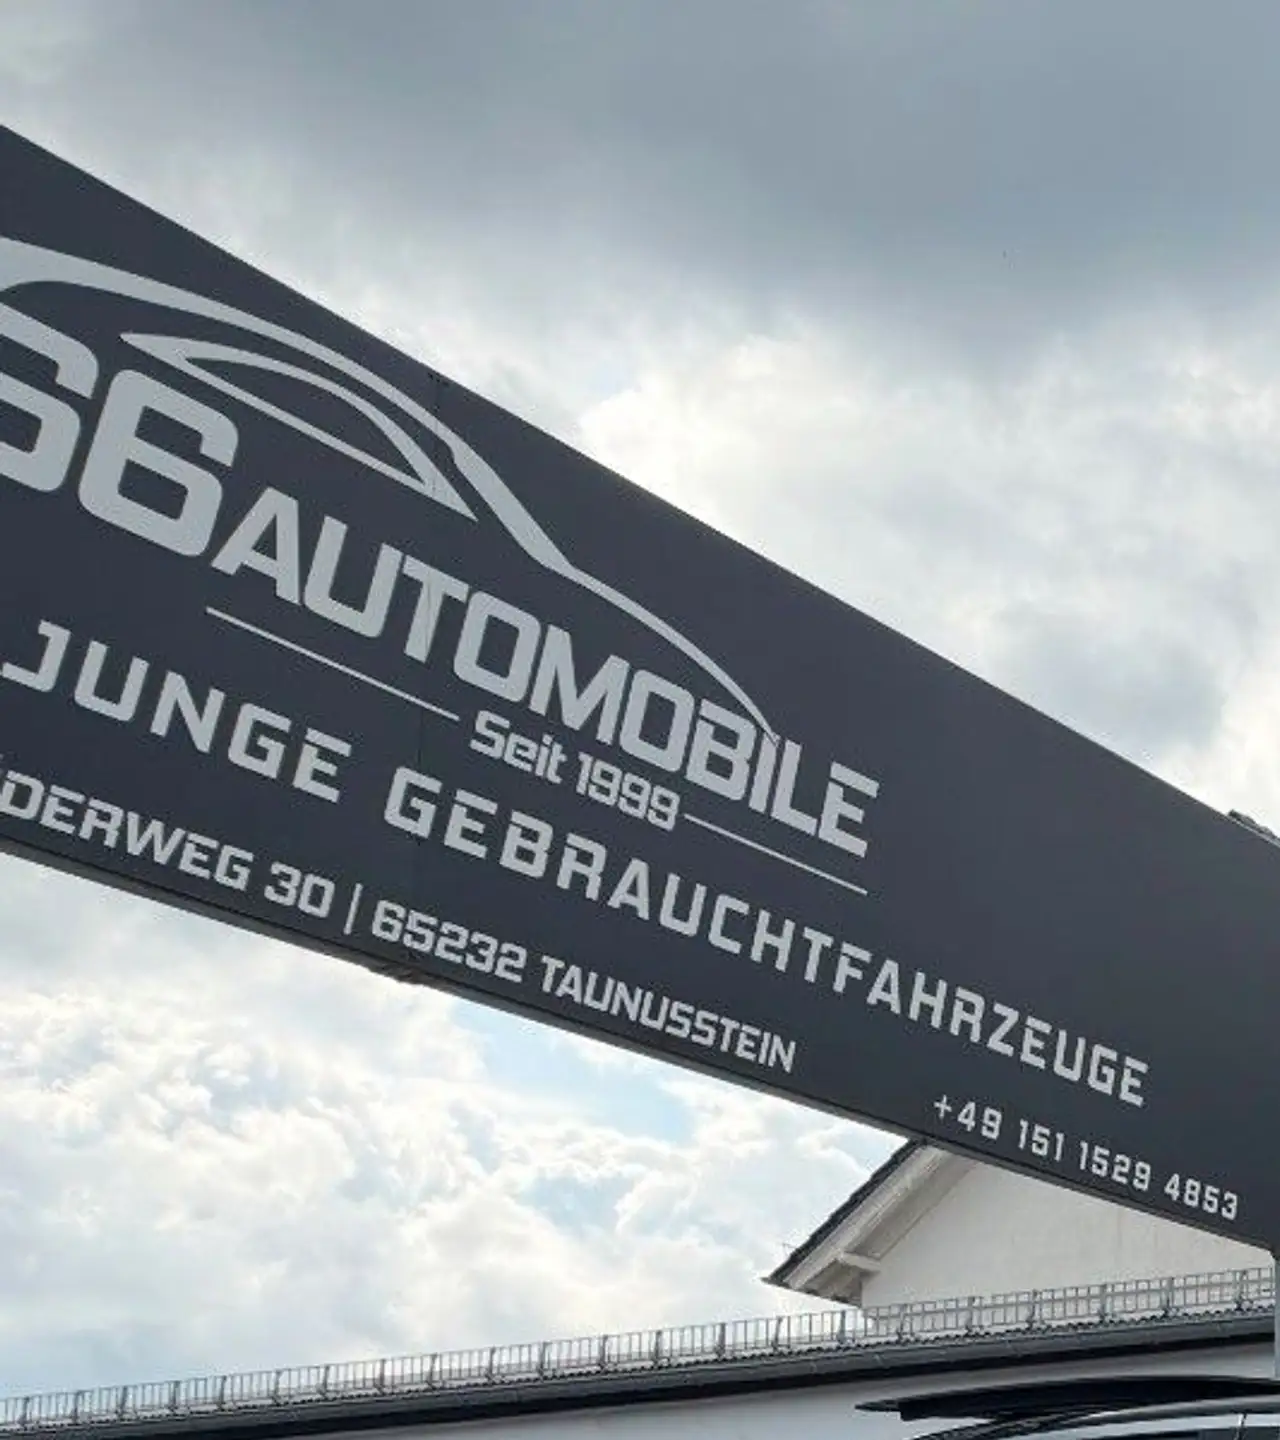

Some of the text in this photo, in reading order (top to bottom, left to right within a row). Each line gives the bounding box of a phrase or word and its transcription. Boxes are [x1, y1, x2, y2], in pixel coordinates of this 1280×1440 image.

[1, 619, 1149, 1107] JUNGE GEBRAUCHTFAHRZEUGE
[470, 709, 680, 832] Seit 1999
[0, 752, 254, 891] DERWEG
[263, 861, 336, 919] 30
[371, 899, 528, 984] 65232
[540, 954, 797, 1073] TAUNUSSTEIN
[933, 1094, 1238, 1221] +49 151 1529 4853
